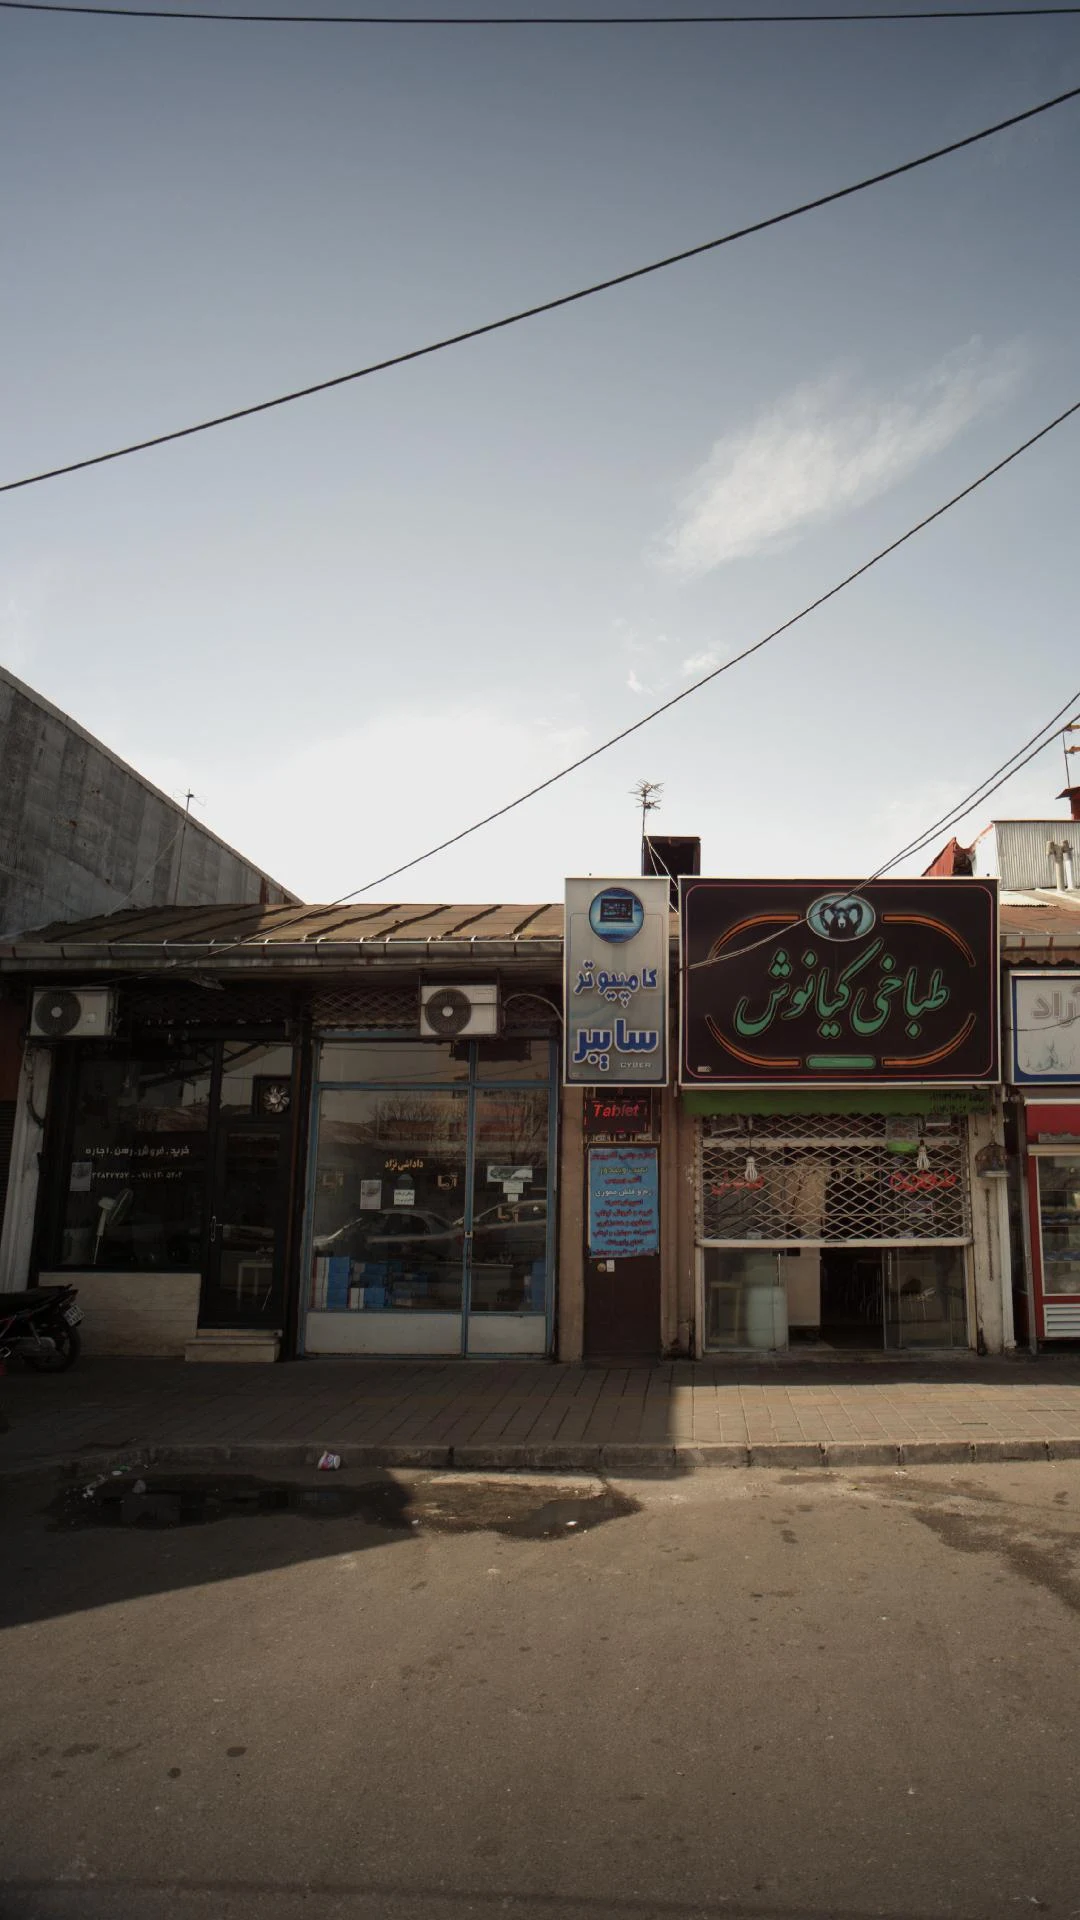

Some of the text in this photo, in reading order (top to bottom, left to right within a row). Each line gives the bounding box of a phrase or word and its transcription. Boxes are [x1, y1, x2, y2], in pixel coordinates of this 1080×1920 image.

[574, 960, 658, 1008] کامپیوتر
[735, 937, 950, 1038] طباخی کیانوش
[573, 1019, 658, 1071] سایبر
[620, 1061, 652, 1069] CYBER
[593, 1103, 640, 1118] Tablet
